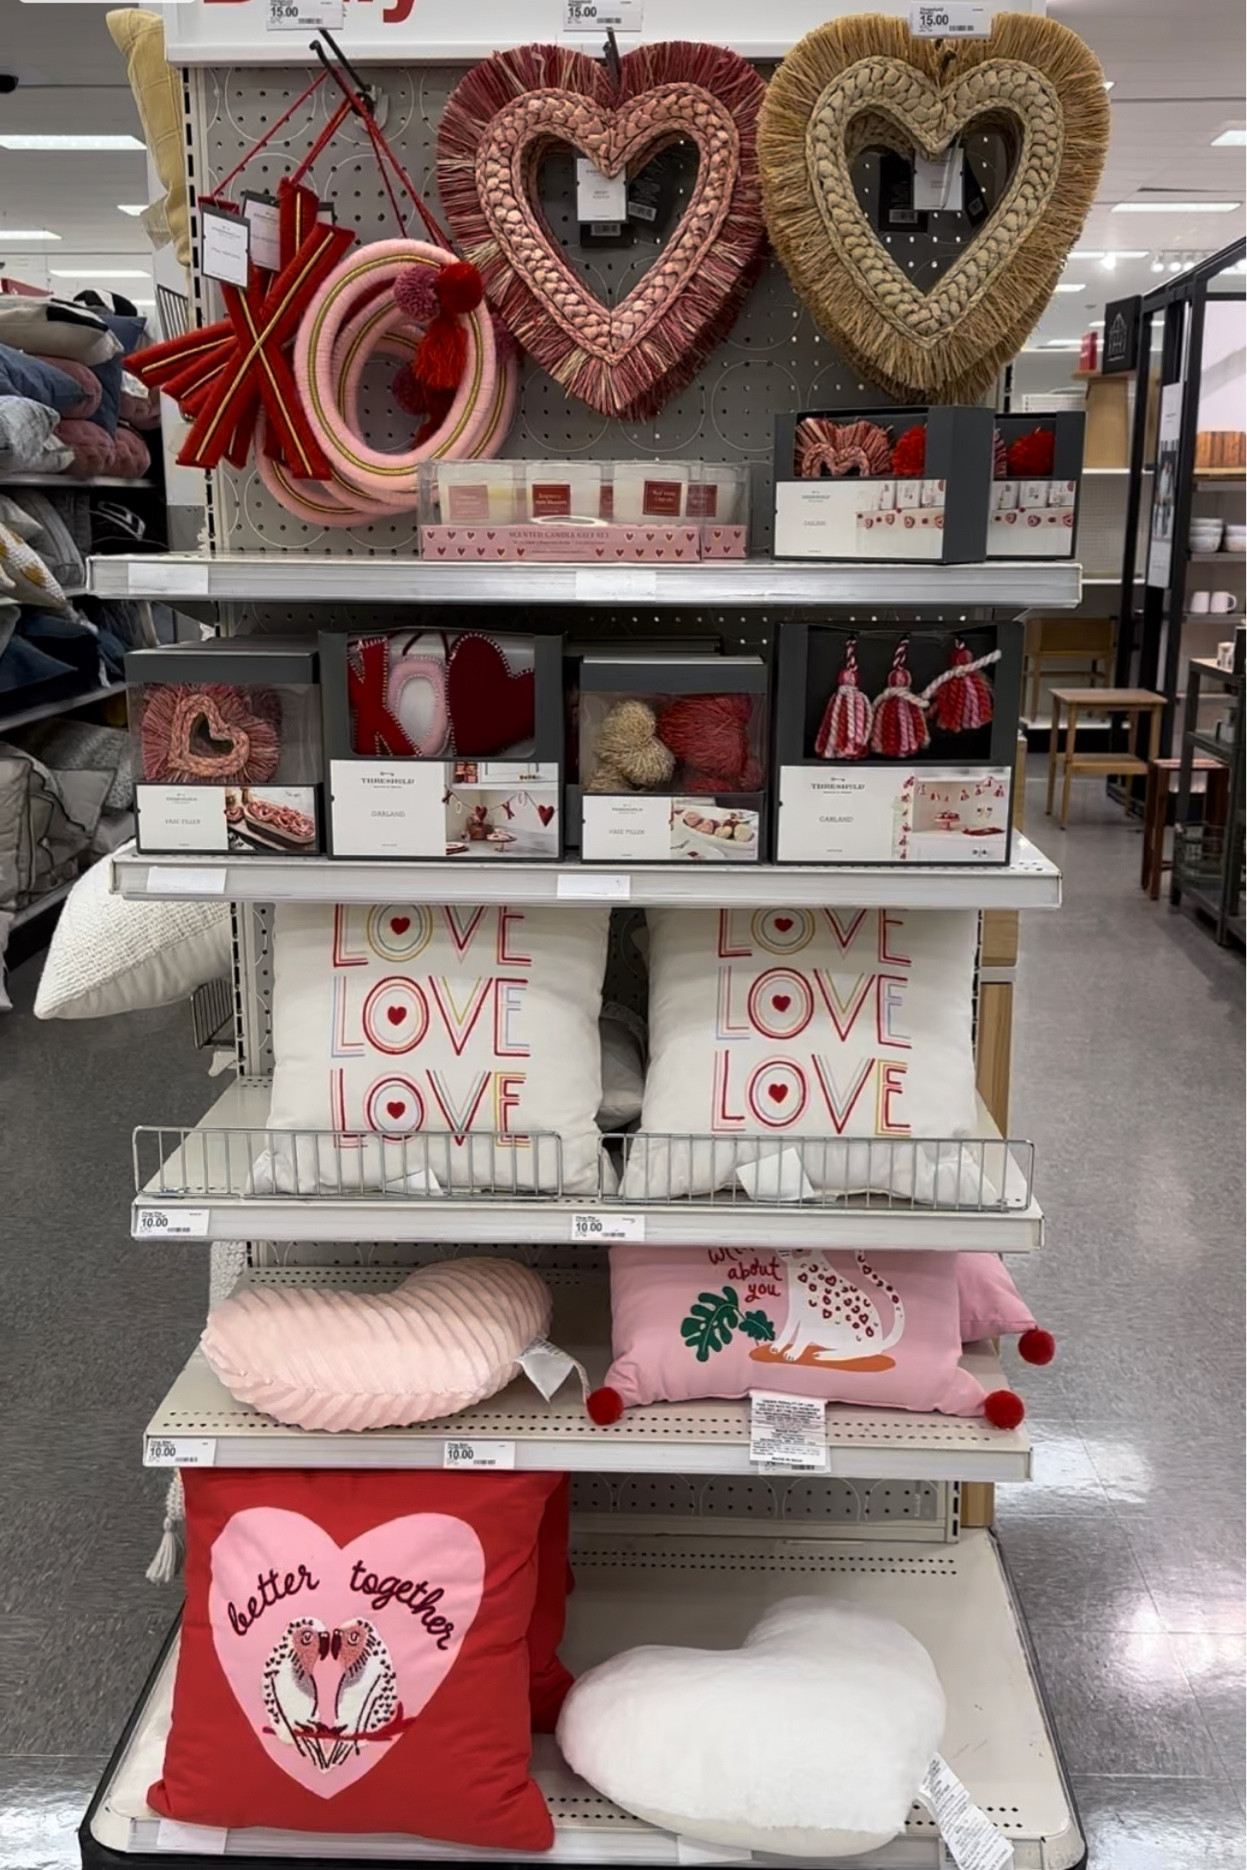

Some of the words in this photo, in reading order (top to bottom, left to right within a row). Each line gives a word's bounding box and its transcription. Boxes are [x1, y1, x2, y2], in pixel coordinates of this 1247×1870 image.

[270, 6, 299, 17] 15.00
[568, 6, 597, 17] 15.00
[920, 14, 949, 25] 15.00
[332, 903, 532, 968] LOVE
[718, 907, 912, 967] LOVE
[330, 974, 531, 1058] LOVE
[714, 965, 912, 1050] LOVE
[711, 1050, 912, 1138] LOVE
[329, 1067, 531, 1149] LOVE
[141, 1217, 168, 1227] 10.00
[576, 1222, 603, 1232] 10.00
[728, 1256, 782, 1281] about
[745, 1283, 781, 1303] you
[150, 1447, 176, 1457] 10.00
[448, 1449, 474, 1460] 10.00
[227, 1563, 320, 1636] better
[349, 1559, 455, 1651] together
